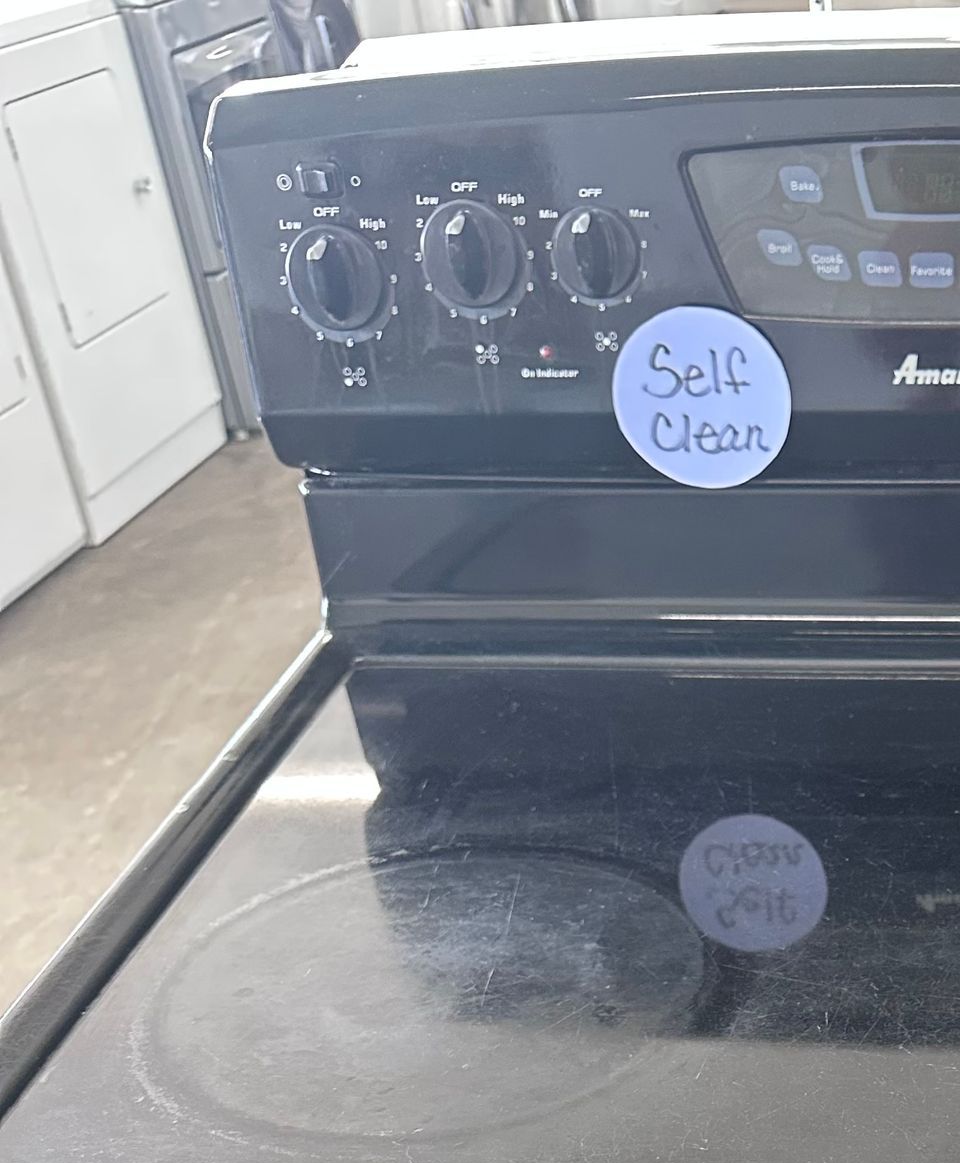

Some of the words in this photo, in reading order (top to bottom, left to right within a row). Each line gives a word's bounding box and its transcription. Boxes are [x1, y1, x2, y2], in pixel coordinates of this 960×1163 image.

[451, 181, 478, 192] OFF
[790, 180, 815, 191] Bake
[578, 188, 603, 198] OFF
[416, 194, 439, 205] Low
[497, 193, 525, 207] High
[313, 206, 340, 217] OFF
[539, 210, 558, 219] Min
[279, 219, 302, 230] Low
[359, 218, 386, 231] High
[416, 218, 424, 228] 2
[513, 216, 526, 226] 10
[280, 243, 288, 252] 2
[375, 240, 388, 250] 10
[545, 241, 552, 249] 2
[767, 243, 792, 254] Broil
[414, 252, 422, 262] 3
[527, 250, 534, 260] 9
[816, 264, 841, 274] Hold
[866, 263, 895, 274] Clean
[910, 265, 953, 277] Favorite
[279, 275, 288, 285] 3
[390, 274, 398, 284] 9
[551, 272, 558, 280] 3
[424, 282, 433, 292] 4
[571, 296, 578, 304] 4
[290, 306, 299, 315] 4
[450, 309, 457, 318] 5
[510, 307, 517, 317] 7
[480, 315, 488, 325] 6
[316, 331, 324, 341] 5
[376, 330, 383, 341] 7
[346, 338, 354, 347] 6
[642, 343, 750, 399] Self
[651, 412, 771, 454] Clean
